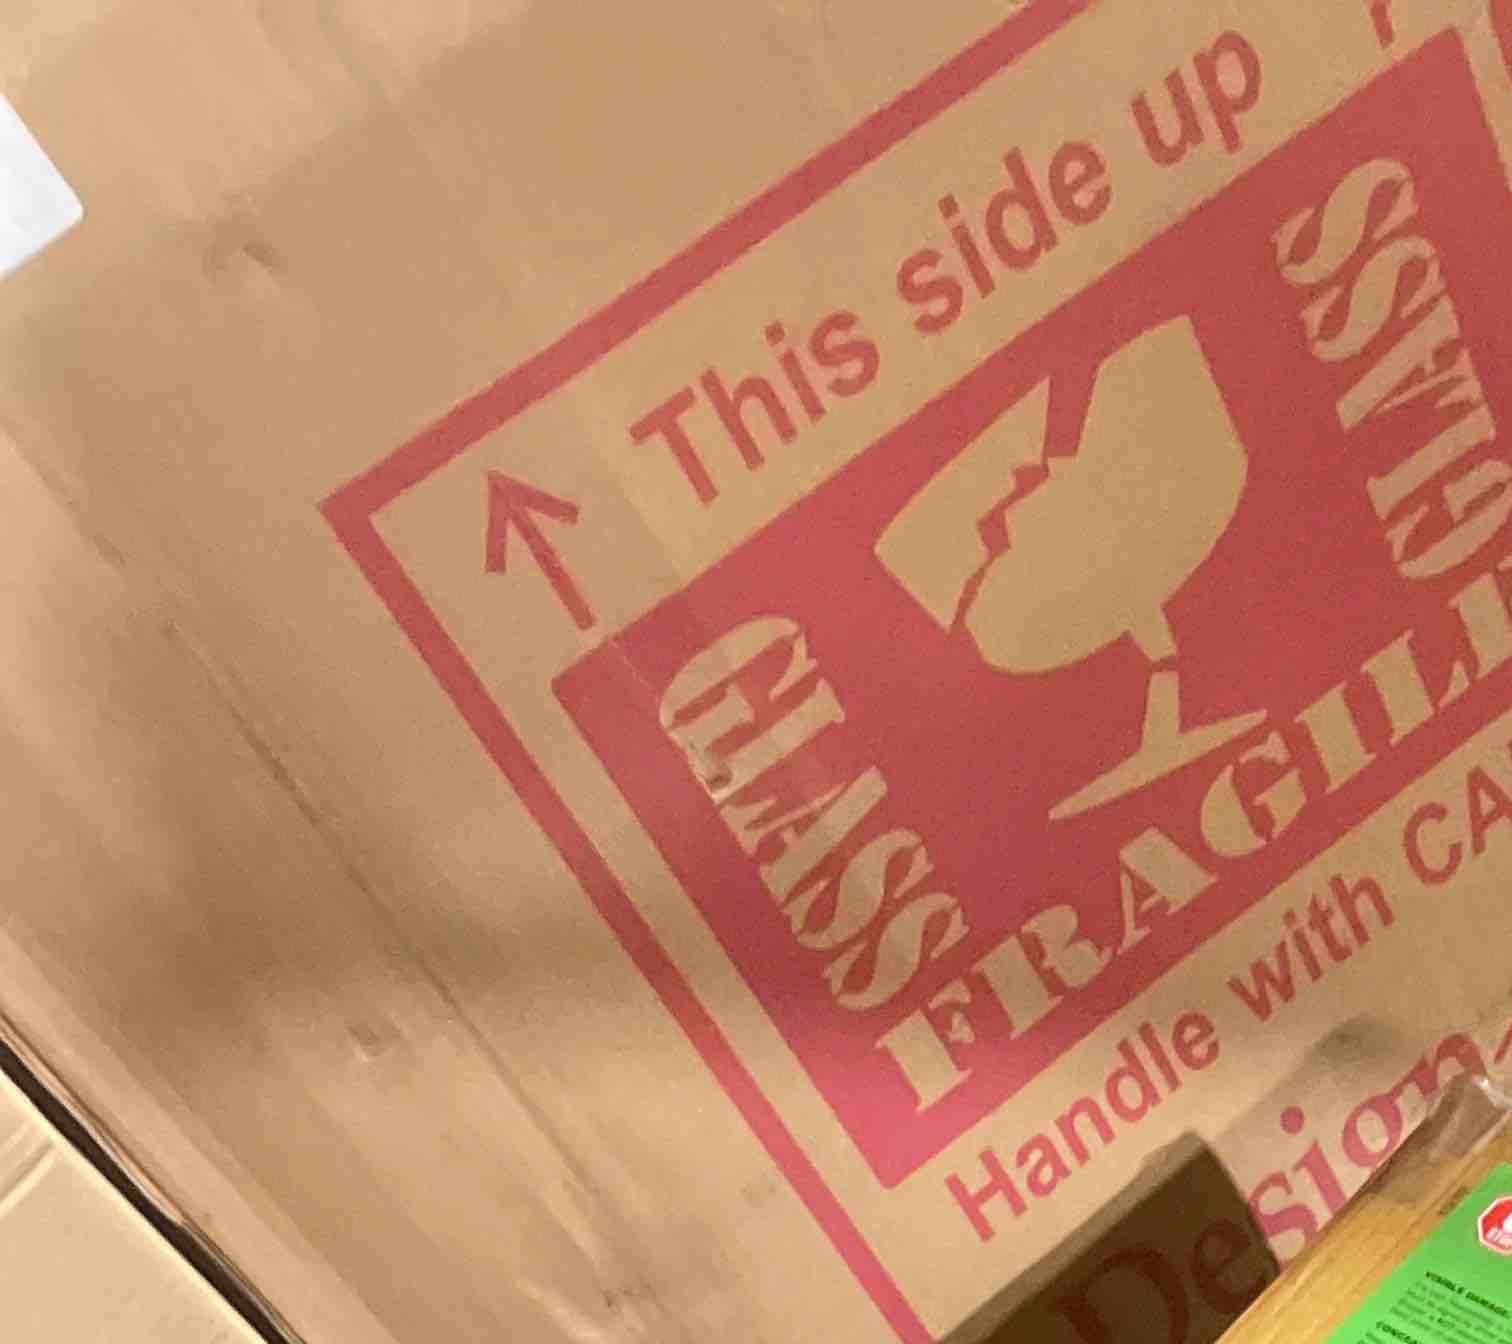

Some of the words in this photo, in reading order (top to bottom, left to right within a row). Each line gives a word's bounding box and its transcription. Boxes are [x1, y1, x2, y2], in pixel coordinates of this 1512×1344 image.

[630, 310, 880, 507] This
[897, 148, 1113, 335] side
[1131, 29, 1262, 153] up
[659, 614, 969, 1011] GLASS
[944, 1009, 1222, 1242] Handle
[1225, 872, 1394, 1024] with
